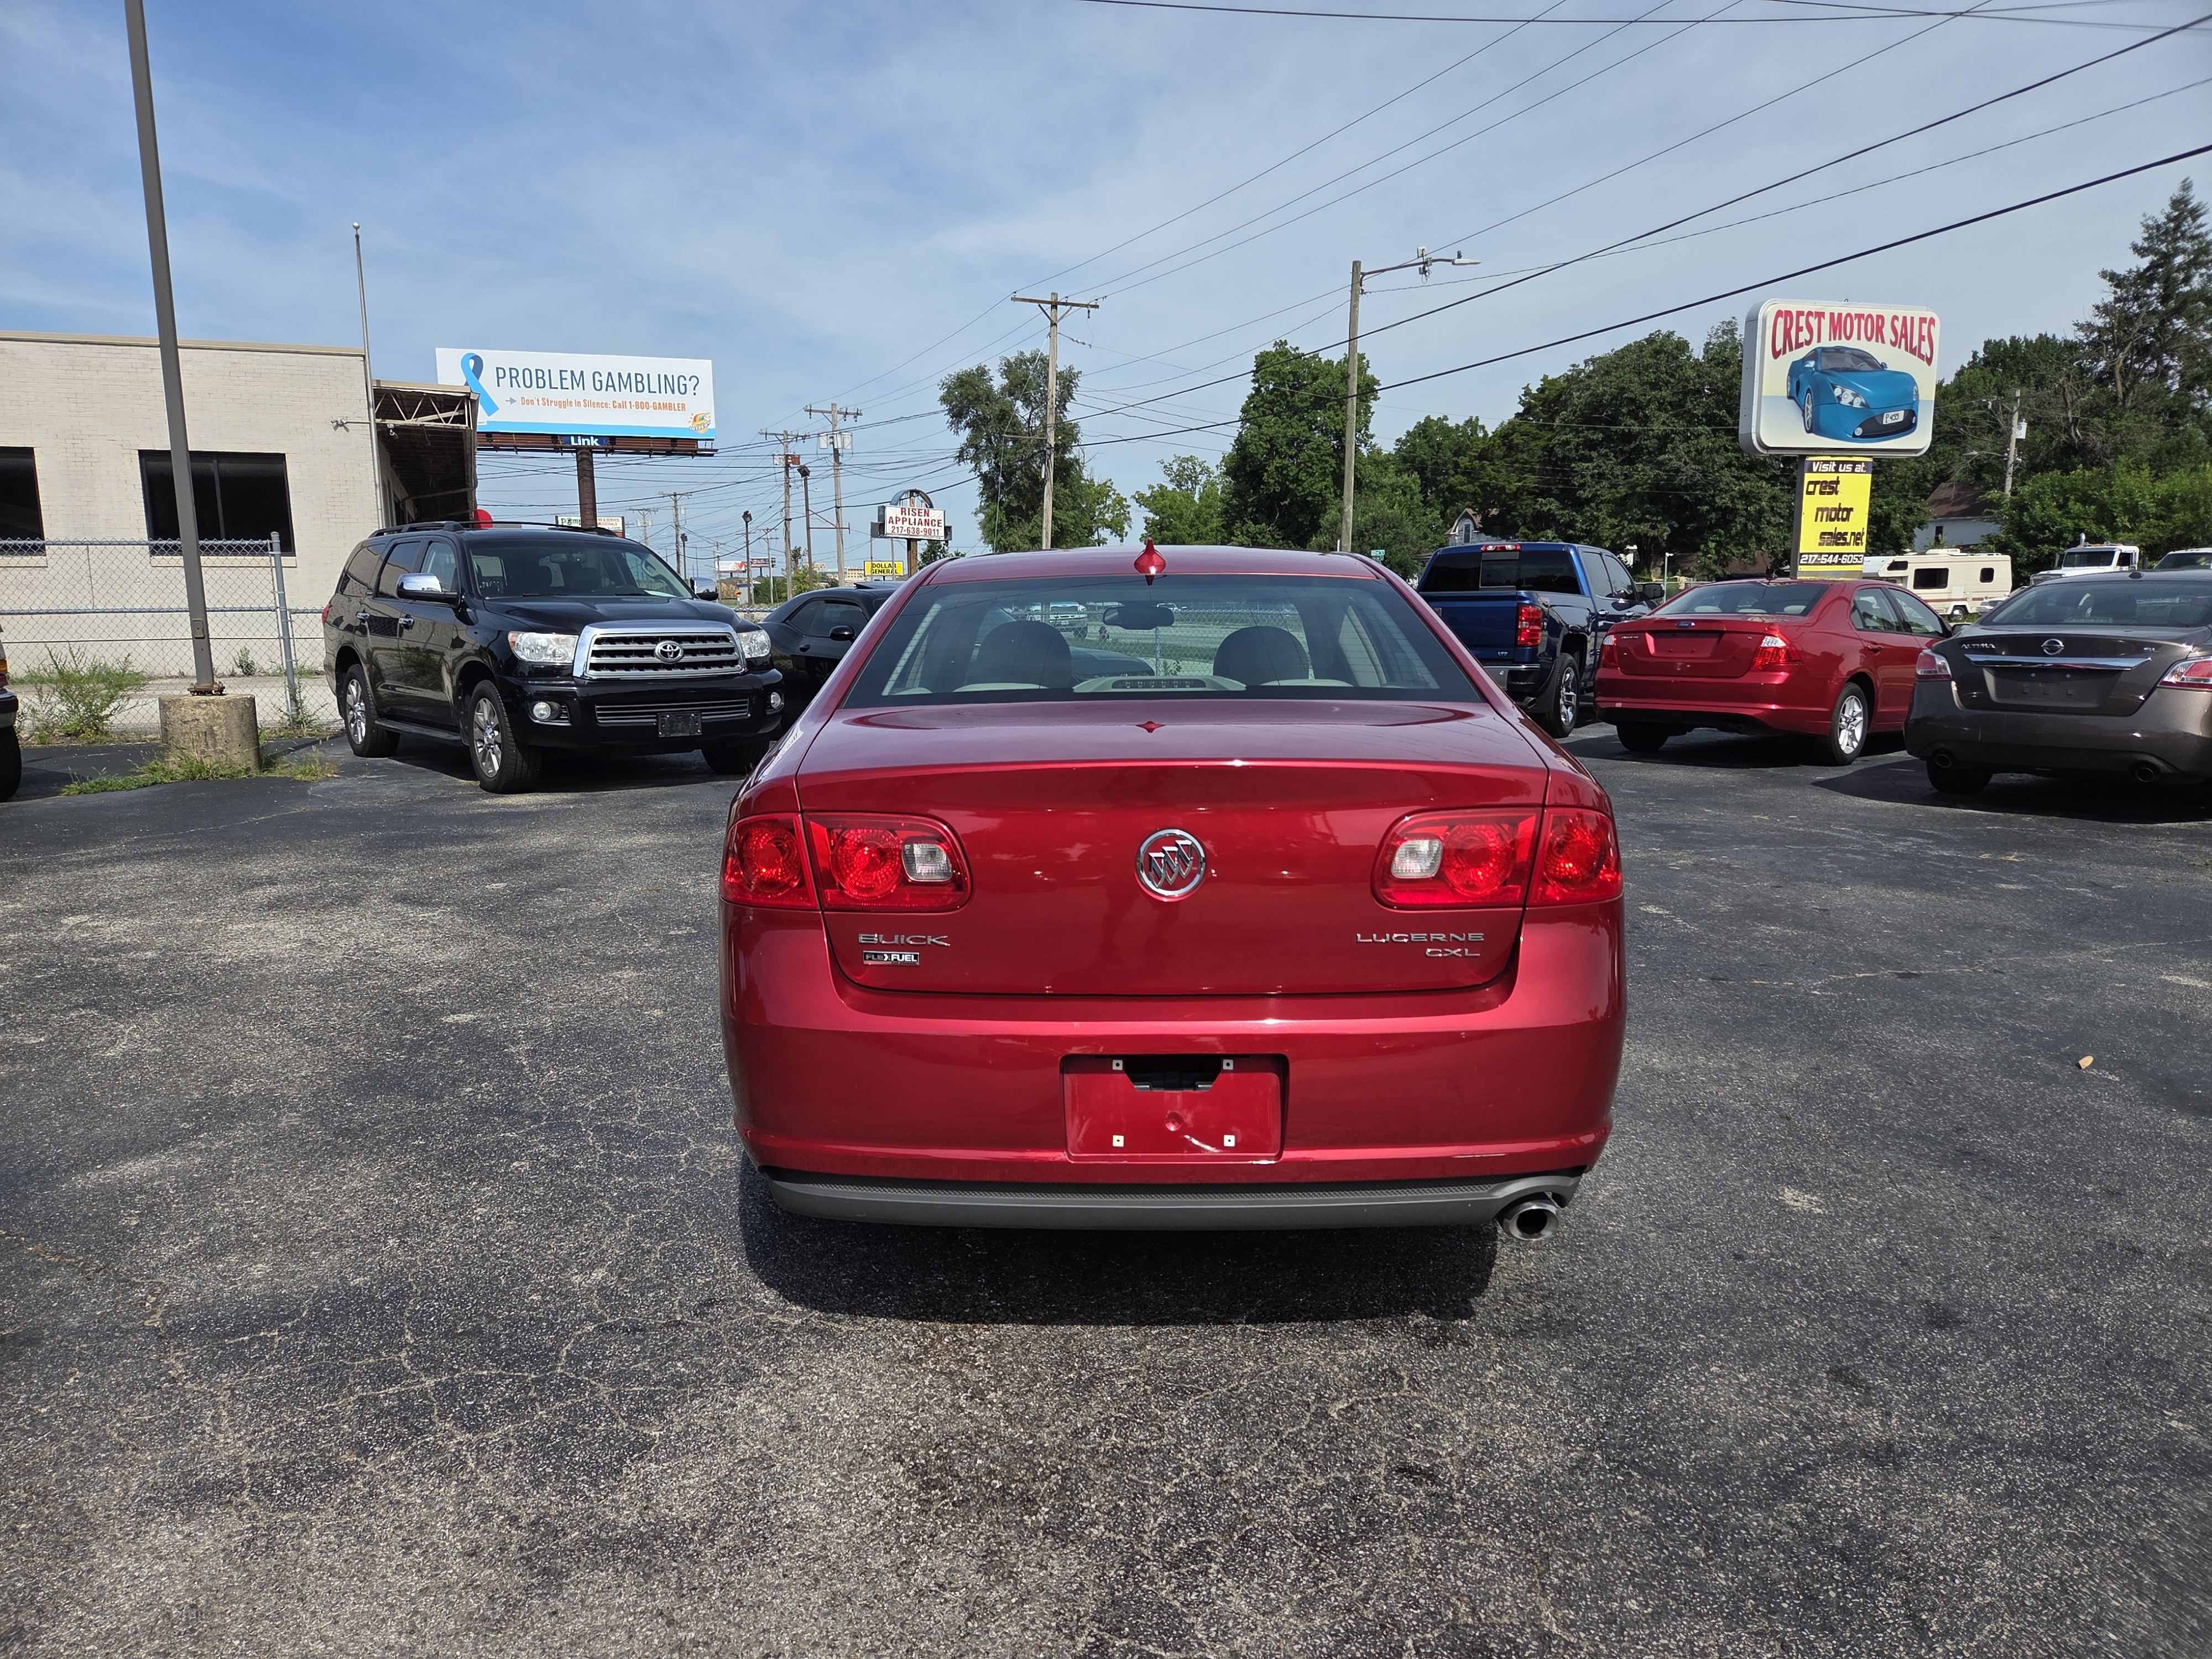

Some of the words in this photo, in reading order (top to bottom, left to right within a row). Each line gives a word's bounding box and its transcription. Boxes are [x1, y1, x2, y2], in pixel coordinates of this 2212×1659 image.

[1771, 309, 1825, 360] CREST
[1828, 312, 1886, 345] MOTOR
[1890, 315, 1936, 367] SALES
[495, 367, 585, 391] PROBLEM
[592, 371, 700, 395] GAMBLING?
[520, 397, 540, 406] Don't
[542, 397, 573, 409] Struggle
[583, 399, 611, 409] Silence:
[612, 400, 627, 409] Call
[628, 400, 686, 412] 1-800-GAMBLER
[570, 436, 601, 446] Link
[1812, 461, 1837, 472] Visit
[1838, 463, 1853, 472] us
[1806, 476, 1840, 495] crest
[900, 507, 930, 518] RISEN
[1814, 502, 1854, 523] motor
[888, 516, 942, 528] APPLIANCE
[891, 525, 940, 536] 217-638-9011
[1818, 526, 1865, 546] sales.net
[1799, 554, 1864, 564] 217-544-6053
[858, 933, 951, 946] BUICK
[1357, 933, 1484, 943] LUCERNE
[1425, 948, 1480, 957] CXL
